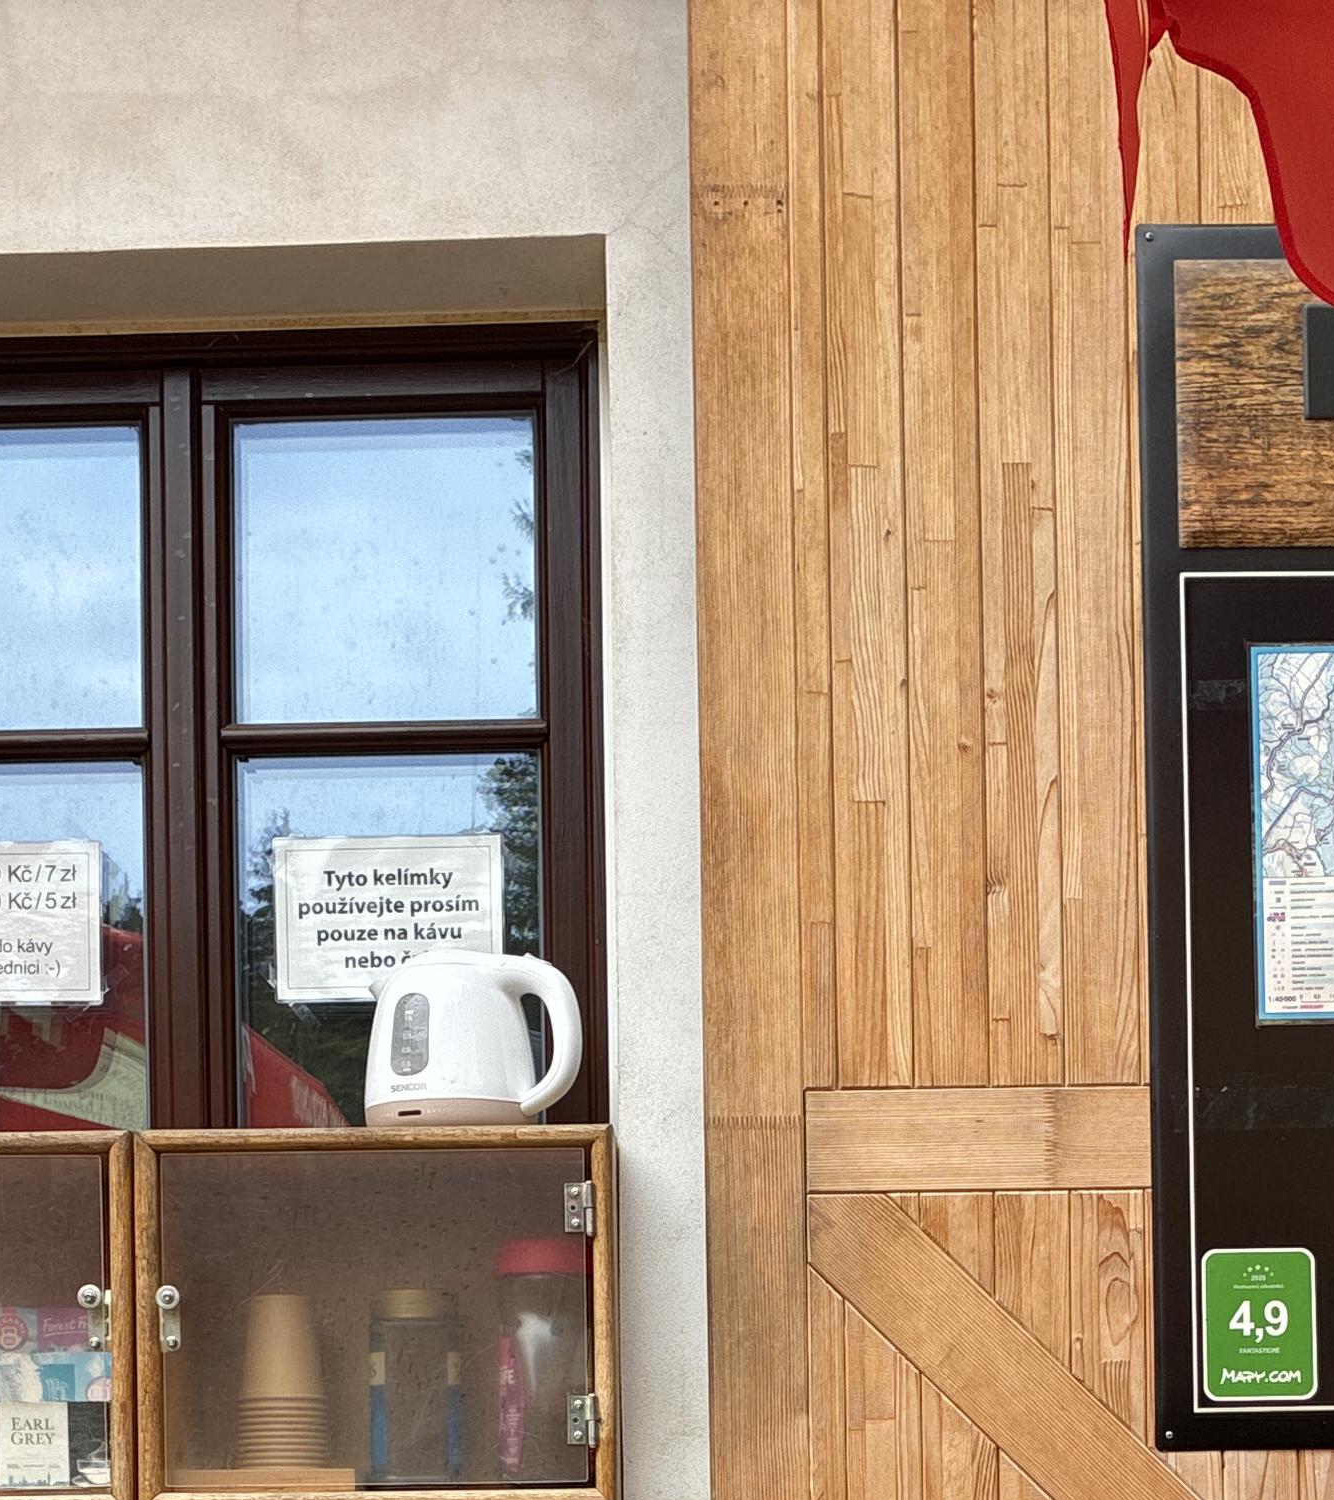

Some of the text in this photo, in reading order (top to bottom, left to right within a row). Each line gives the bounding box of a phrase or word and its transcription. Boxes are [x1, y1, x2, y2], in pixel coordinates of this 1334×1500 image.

[323, 868, 453, 891] Tyto kelímky
[298, 895, 480, 919] používejte prosím
[317, 923, 462, 946] pouze na kávu
[17, 939, 53, 956] kávy
[345, 951, 396, 969] nebo
[390, 1082, 428, 1093] SENCOR
[1229, 1300, 1288, 1343] 4,9
[11, 1417, 55, 1431] EARL
[10, 1432, 56, 1445] GREY
